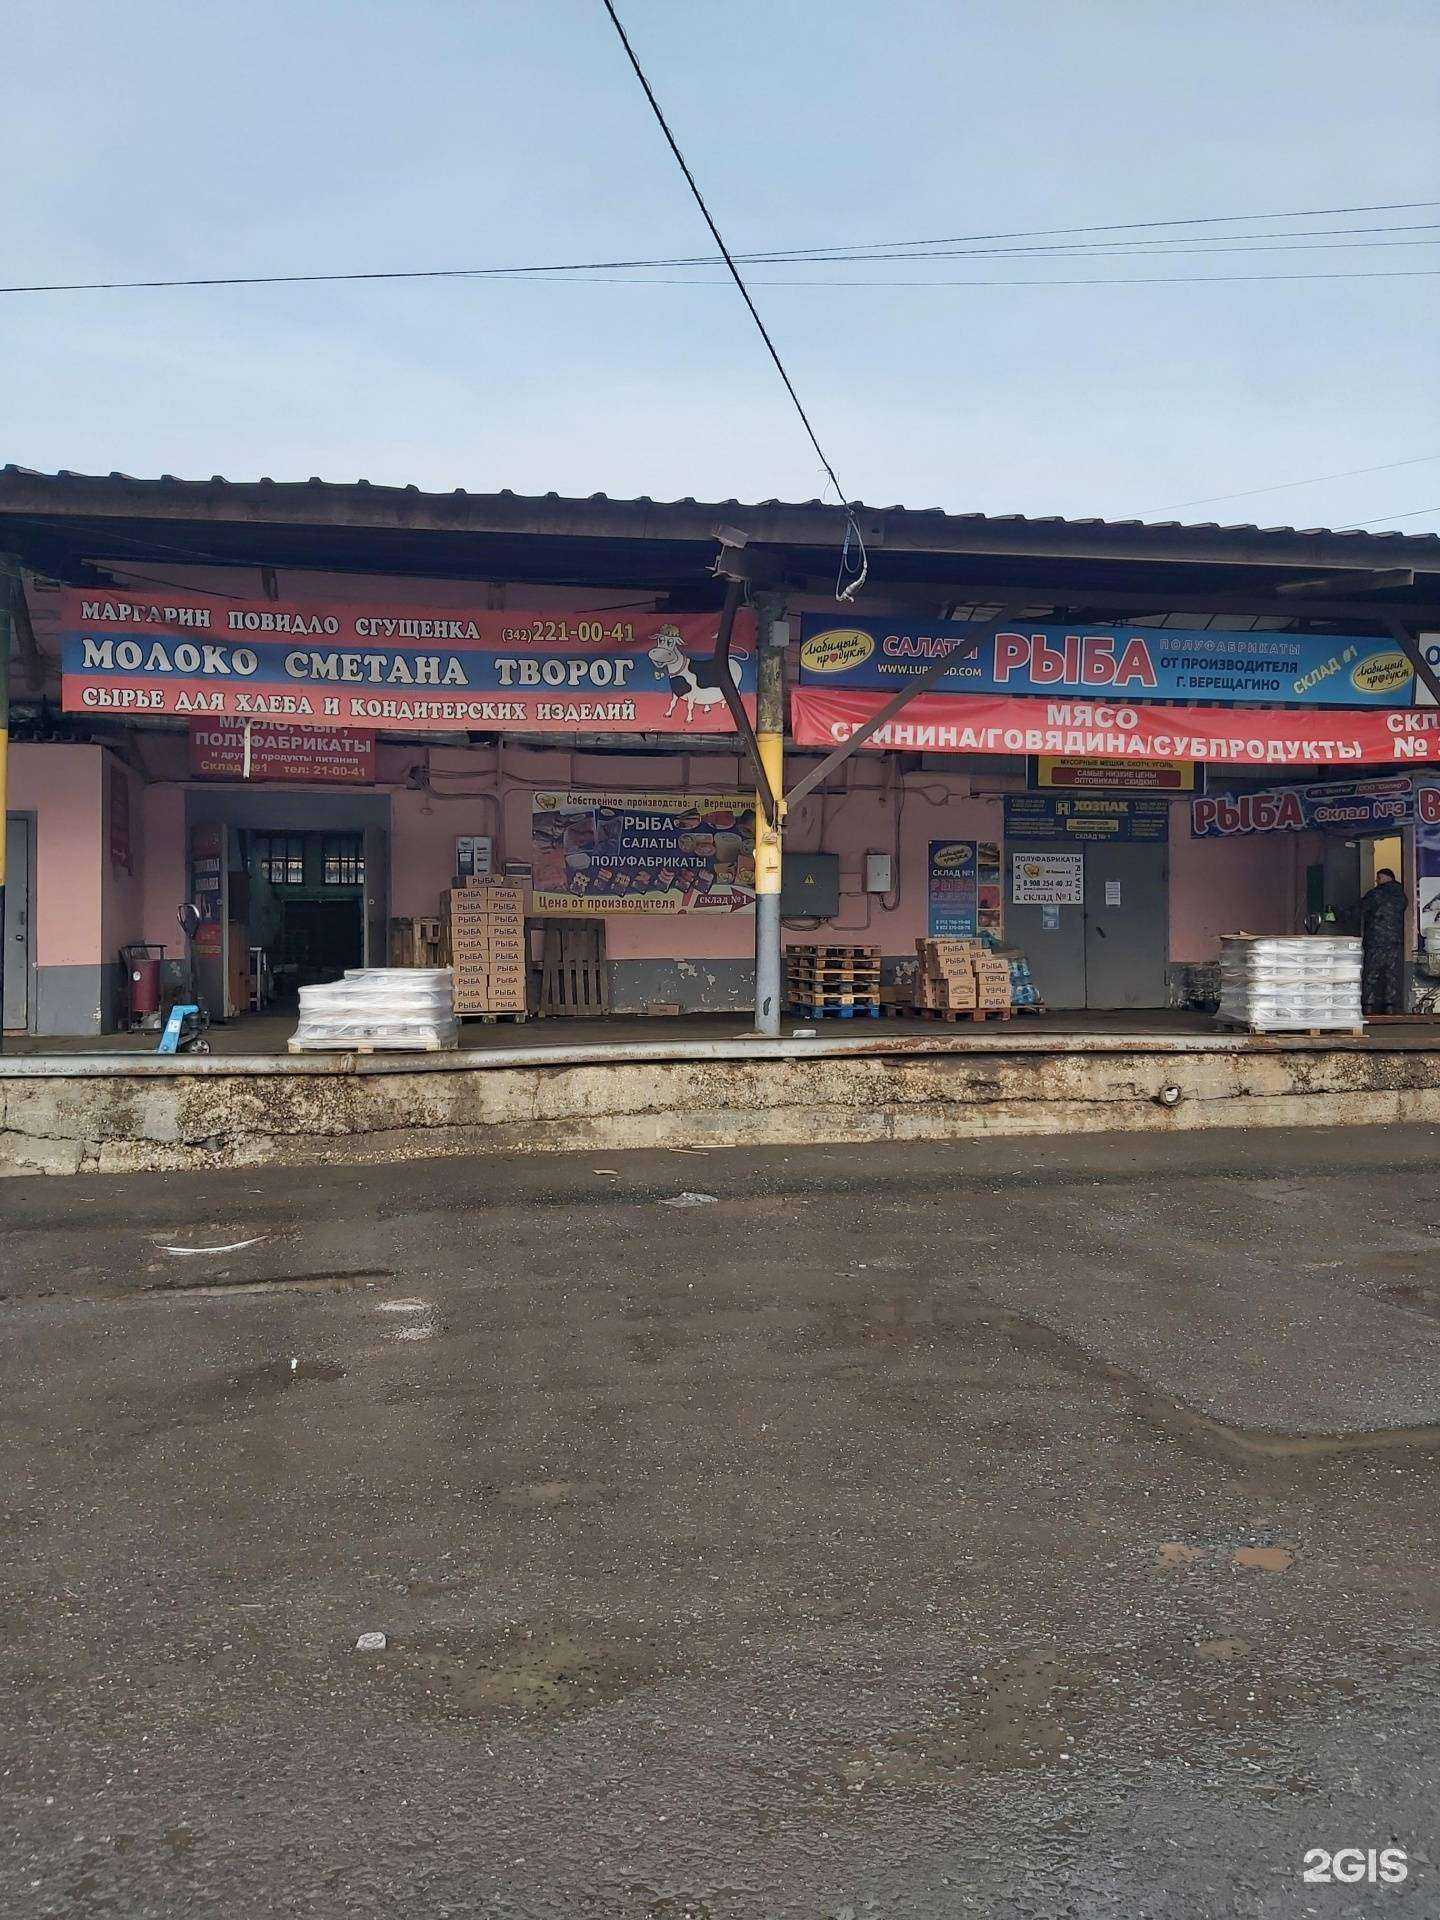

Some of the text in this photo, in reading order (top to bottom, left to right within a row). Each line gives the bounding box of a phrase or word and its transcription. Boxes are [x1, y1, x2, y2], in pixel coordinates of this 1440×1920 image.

[81, 601, 636, 643] МАРГАРИН ПОВИДЛО СГУЩЕНКА (342)221-00-41
[1159, 638, 1301, 656] ПОЛУФАБРИКАТЫ
[81, 638, 635, 688] МОЛОКО СМЕТАНА ТВОРОГ
[992, 632, 1158, 688] РЫБА
[1160, 657, 1299, 674] ОТ ПРОИЗВОДИТЕЛЯ
[876, 662, 983, 677] WWW.LUPD.COM
[1293, 657, 1342, 694] СКЛАД
[1189, 676, 1281, 692] ВЕРЕЩАГИНО
[81, 686, 636, 722] СЫРЬЕ ДЛЯ ХЛЕБА И КОНДИТЕРСКИХ ИЗДЕЛИЙ
[1046, 703, 1139, 730] МЯСО
[195, 733, 372, 753] ПОЛУФАБРИКАТЫ
[221, 752, 258, 761] друге
[261, 753, 312, 764] продукты
[315, 755, 360, 764] питания
[201, 760, 241, 772] Склад
[284, 765, 310, 775] тел:
[313, 765, 366, 776] 21-00-41
[566, 795, 623, 807] Собственное
[1193, 792, 1307, 835] РЫБА
[624, 817, 675, 831] РЫБА
[622, 837, 678, 849] САЛАТЫ
[591, 855, 707, 868] ПОЛУФАБРИКАТЫ
[932, 869, 961, 878] СКЛАД
[539, 897, 568, 912] Цена
[571, 899, 584, 909] от
[588, 898, 676, 911] производителя
[1023, 893, 1053, 902] склад
[493, 903, 516, 911] РЫБА
[459, 965, 483, 973] РЫБА
[981, 962, 1003, 970] РЫБА
